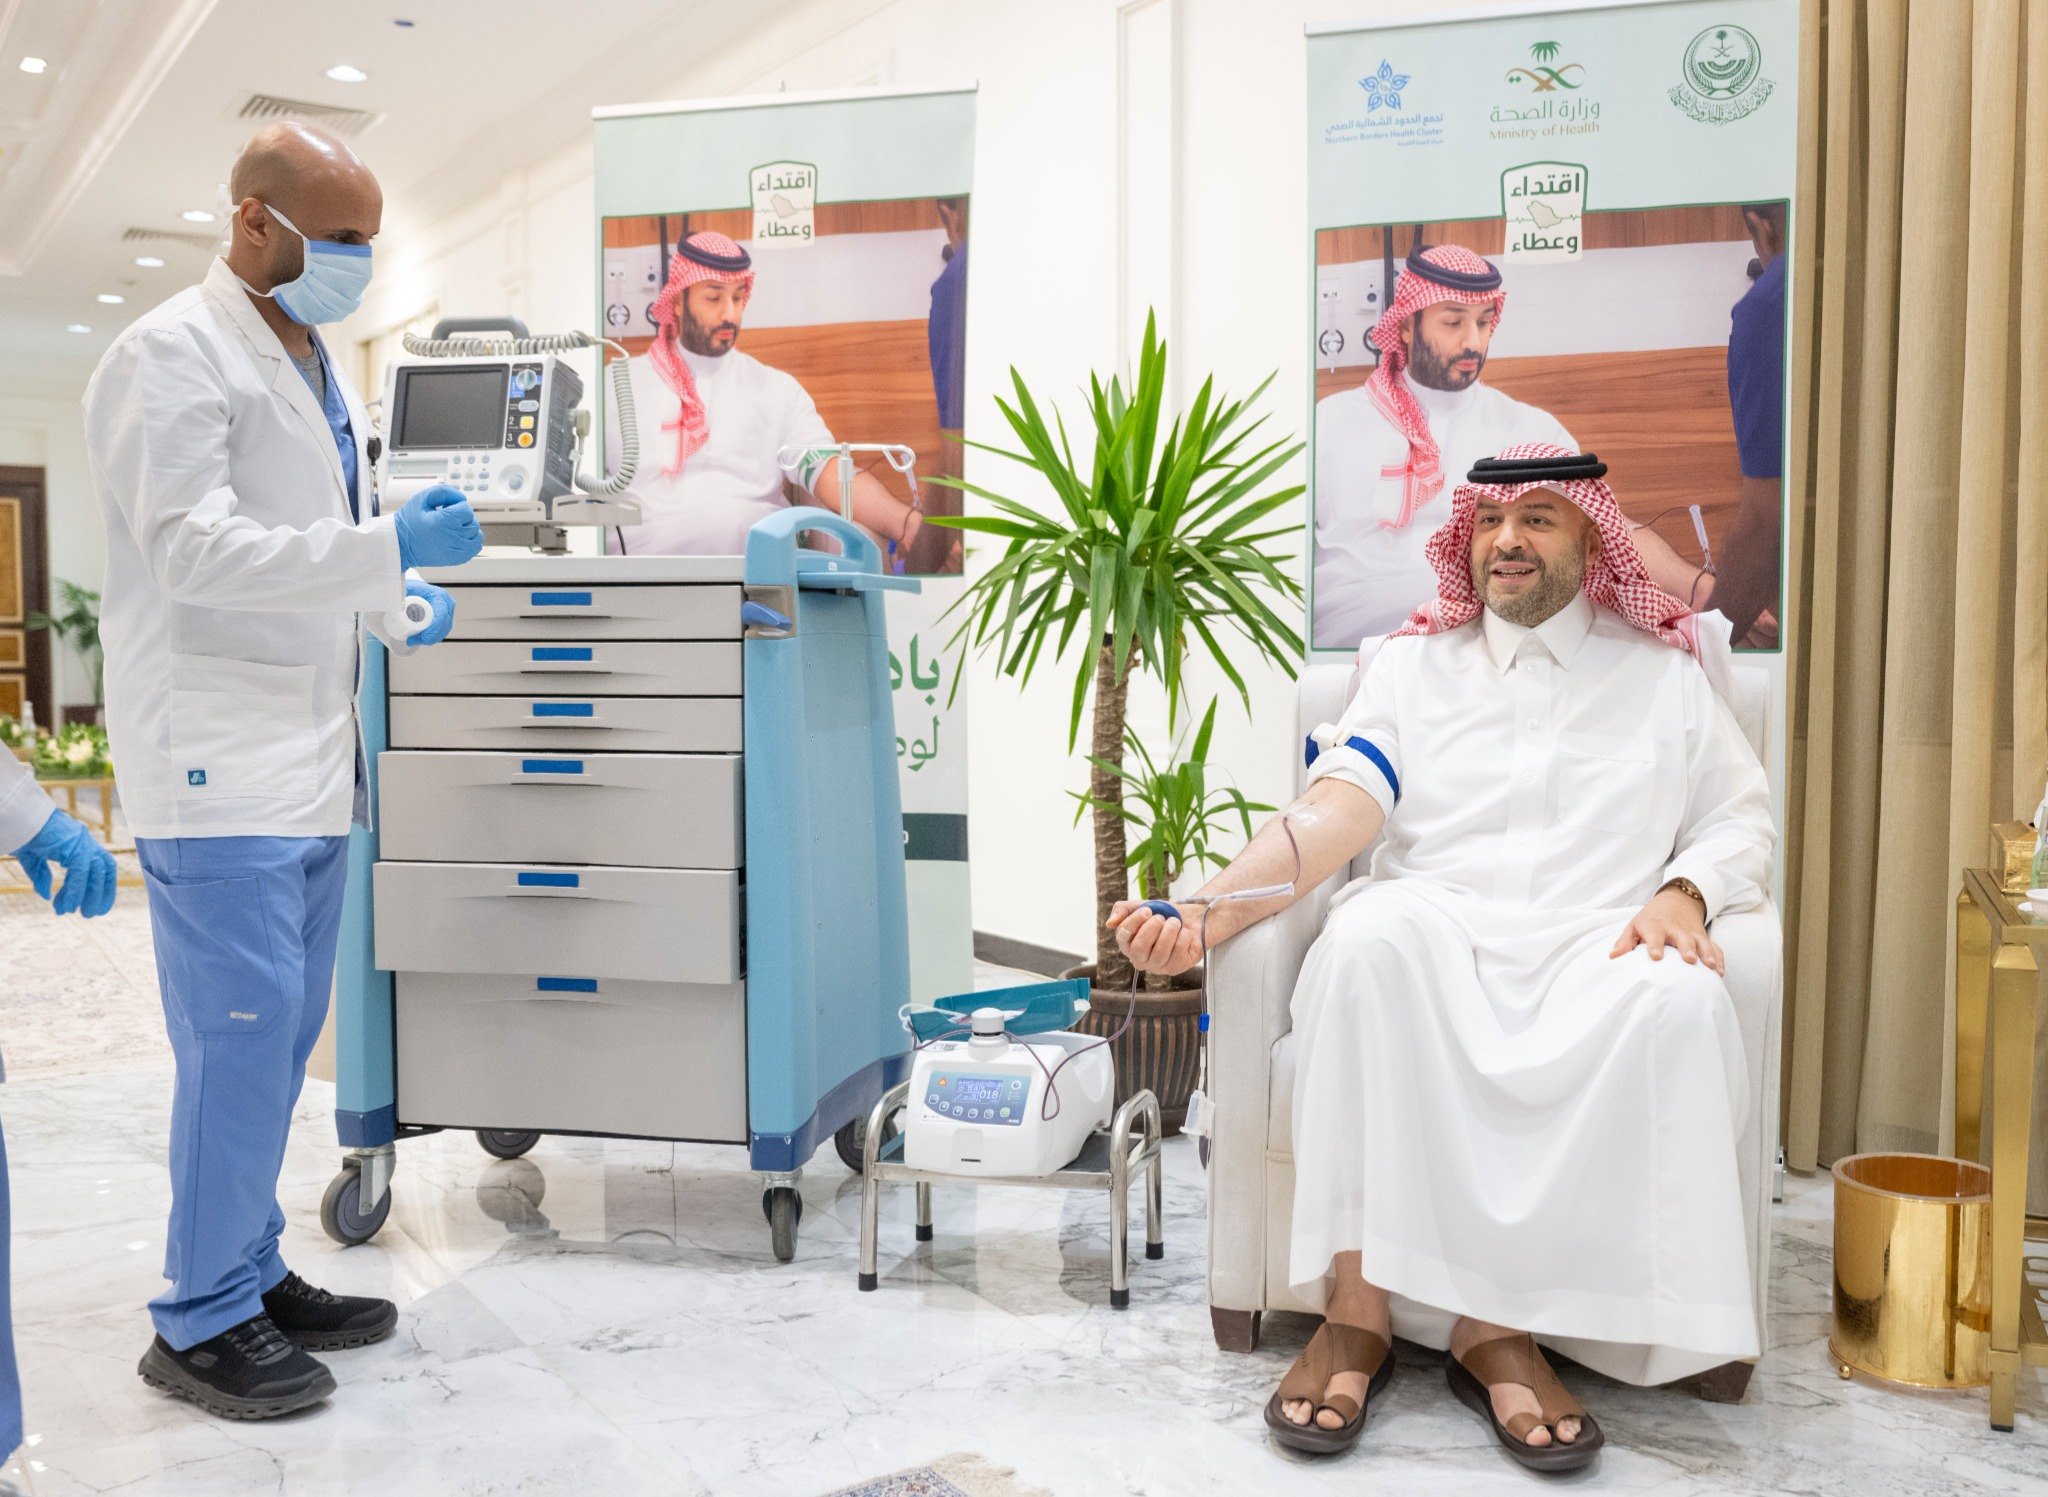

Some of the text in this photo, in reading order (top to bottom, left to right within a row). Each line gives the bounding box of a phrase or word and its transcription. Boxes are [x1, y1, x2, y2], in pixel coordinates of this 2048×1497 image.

[1490, 97, 1600, 122] وزارة الصحة
[1325, 127, 1443, 145] Northern Borders Health Cluster
[1489, 121, 1600, 140] Ministry of Health
[757, 170, 811, 191] اقتداء
[1511, 172, 1580, 197] اقتداء
[759, 221, 811, 241] وعطاء
[1511, 232, 1578, 254] وعطاء
